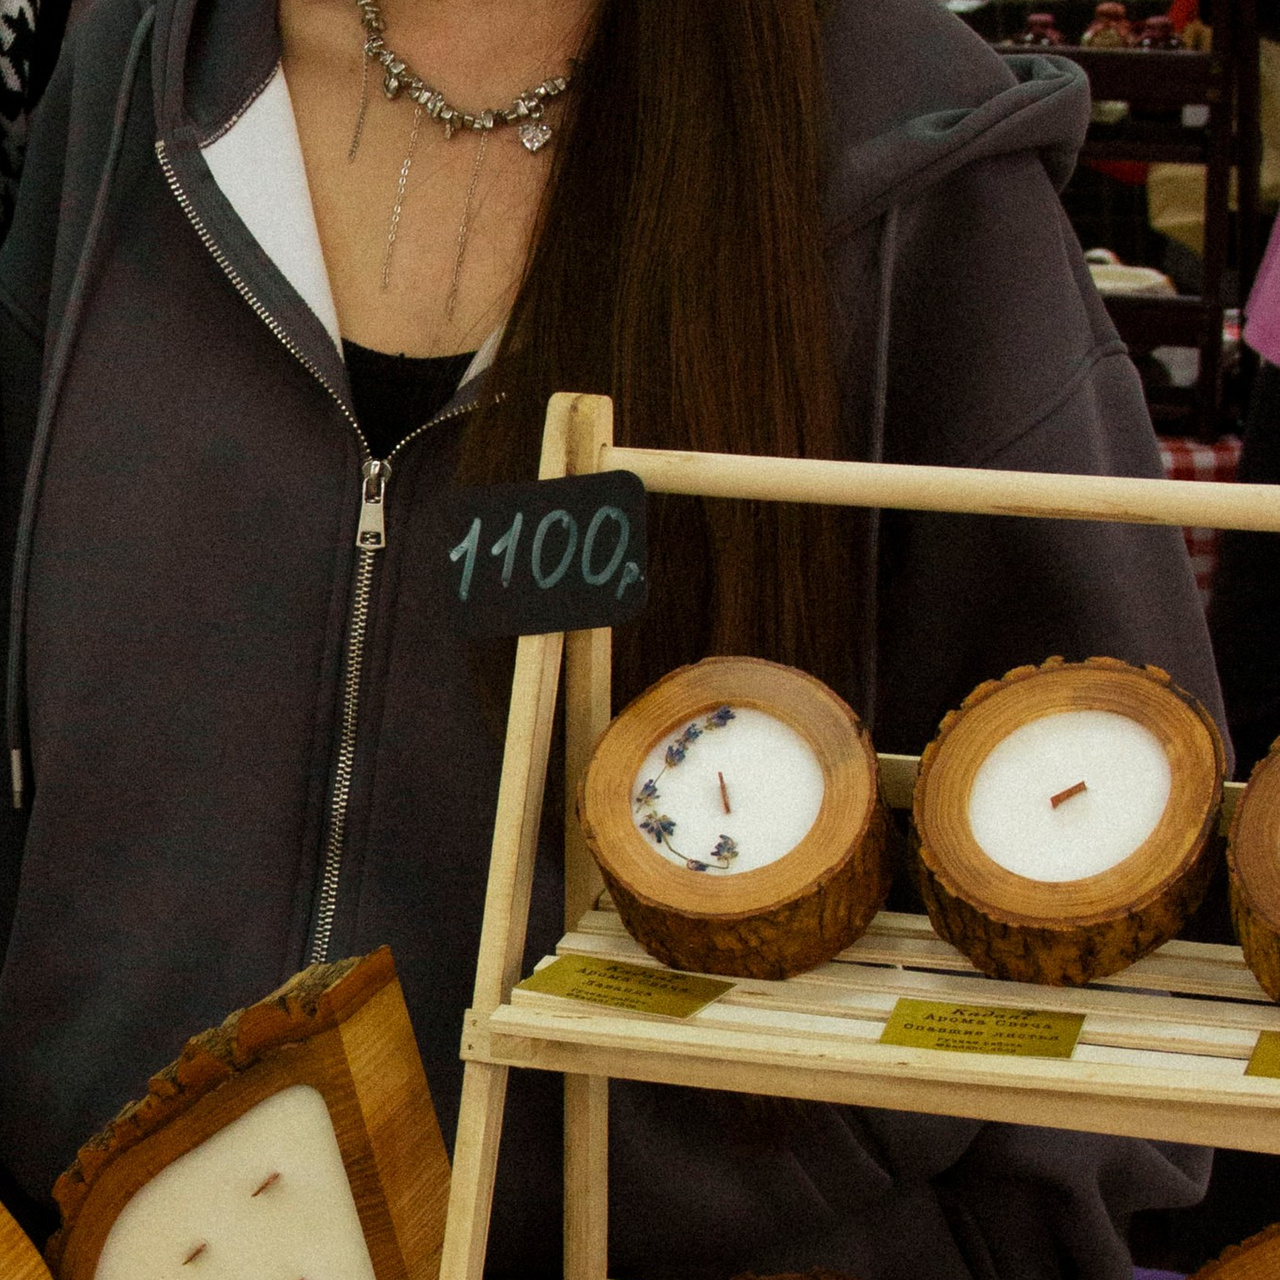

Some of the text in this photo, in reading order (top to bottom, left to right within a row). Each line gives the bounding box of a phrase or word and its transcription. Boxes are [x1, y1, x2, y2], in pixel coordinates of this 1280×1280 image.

[575, 967, 630, 983] Арома
[925, 1013, 1054, 1030] Арома Свеча
[903, 1023, 1060, 1042] Опавшие листья
